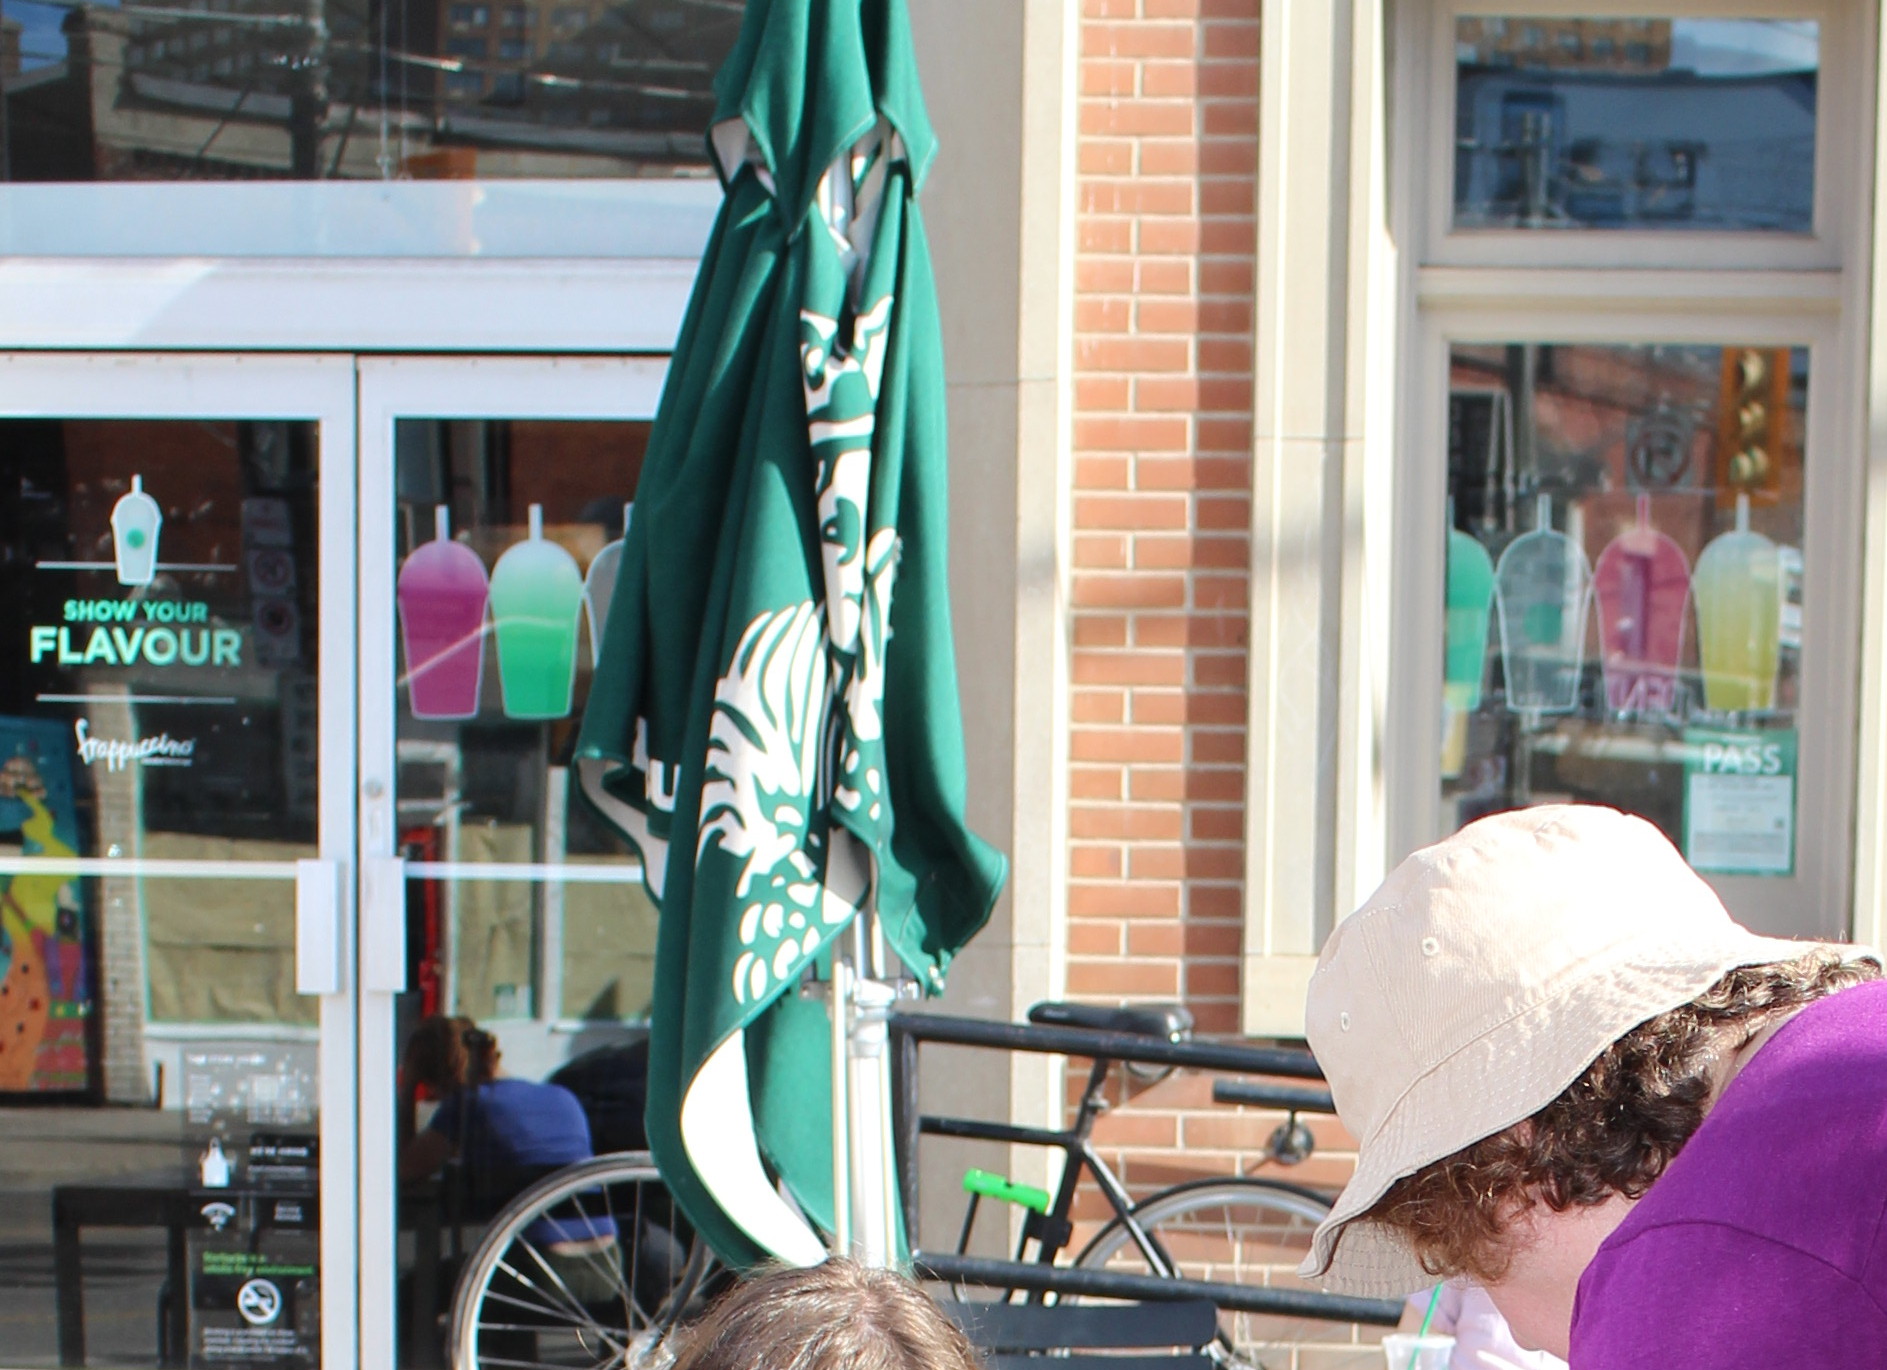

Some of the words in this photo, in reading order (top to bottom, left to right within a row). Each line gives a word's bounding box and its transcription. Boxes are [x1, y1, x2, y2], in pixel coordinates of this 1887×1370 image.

[64, 599, 137, 621] SHOW
[142, 601, 208, 622] YOUR
[30, 625, 242, 666] FLAVOUR
[1704, 742, 1782, 774] PASS
